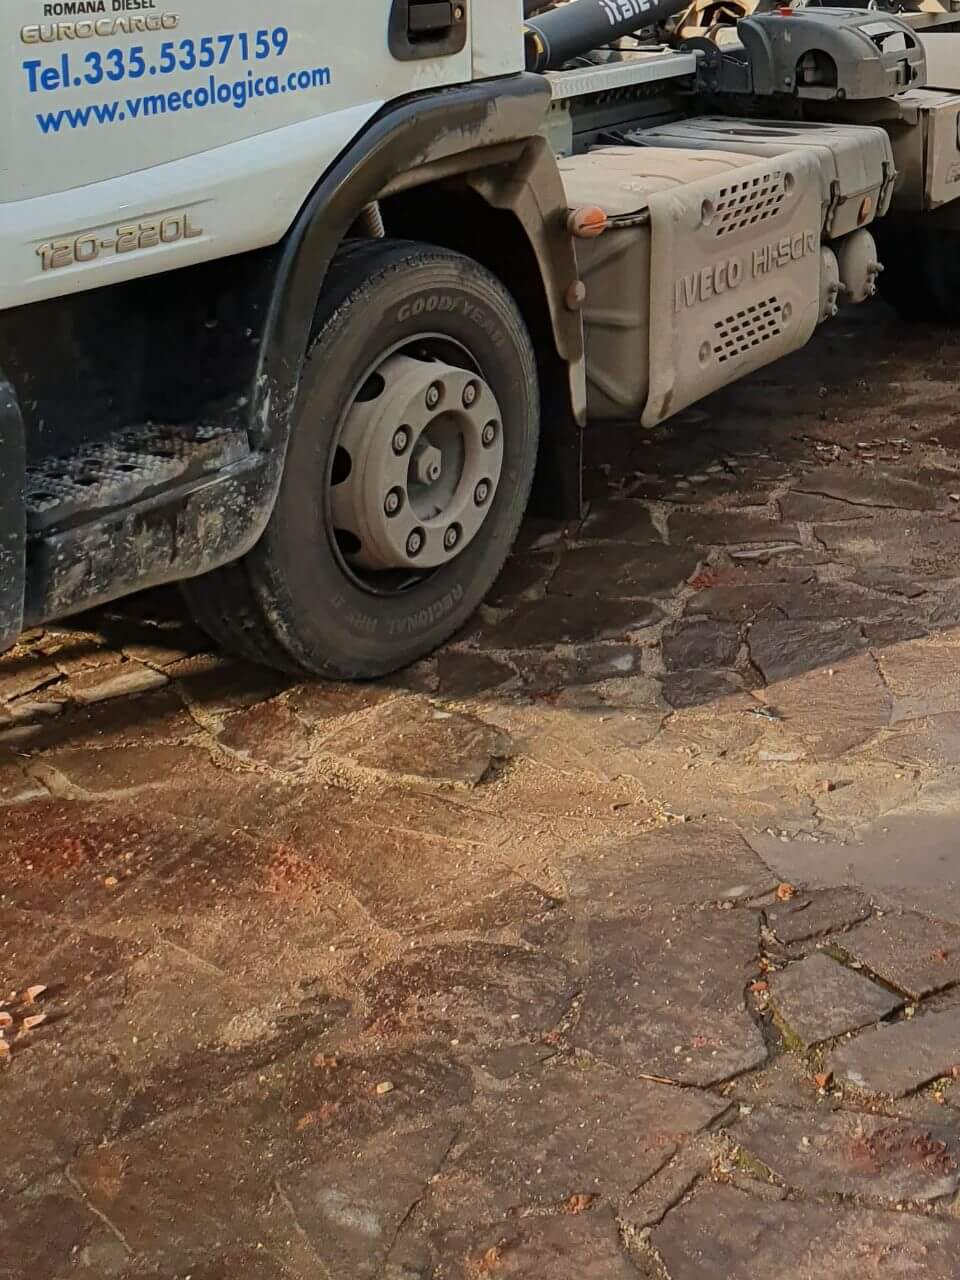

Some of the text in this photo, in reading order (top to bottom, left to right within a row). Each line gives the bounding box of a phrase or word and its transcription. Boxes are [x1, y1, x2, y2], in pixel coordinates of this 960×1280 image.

[21, 12, 180, 44] EUROCARGO
[43, 0, 106, 17] ROMANA
[23, 27, 289, 92] Tel.335.5357159
[36, 66, 331, 134] www.vmecologica.com
[36, 212, 203, 272] 120-220L
[674, 231, 817, 313] IVECO HI-SCR
